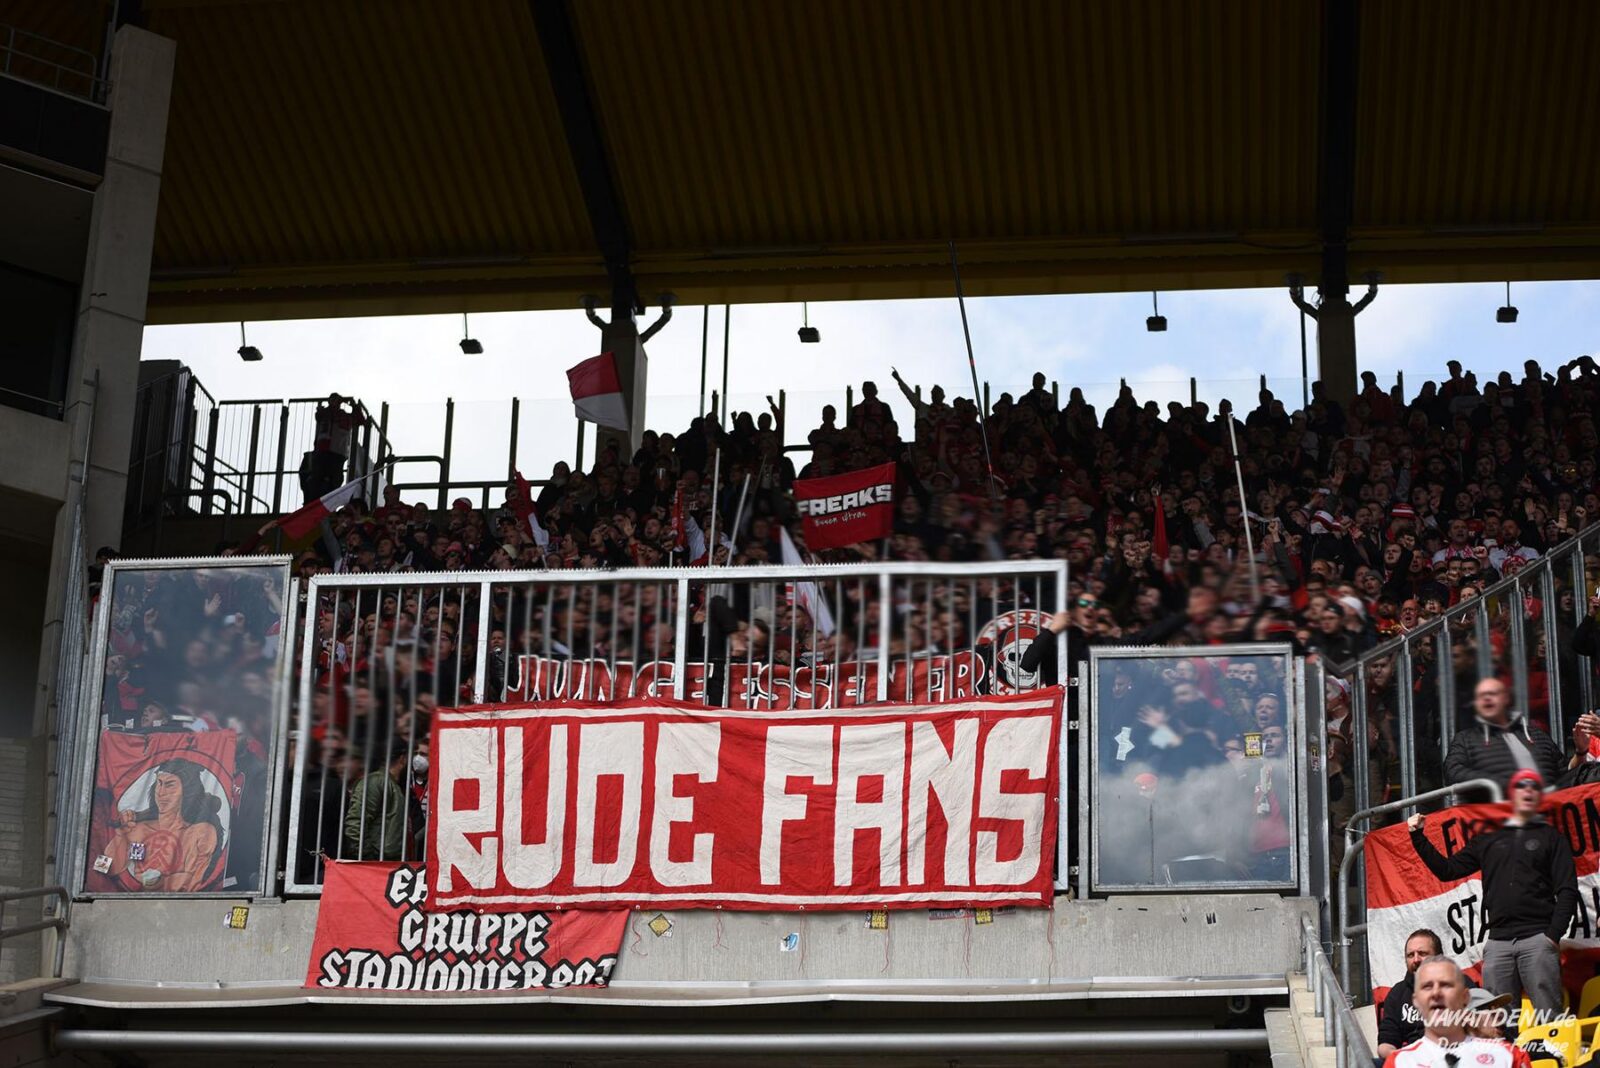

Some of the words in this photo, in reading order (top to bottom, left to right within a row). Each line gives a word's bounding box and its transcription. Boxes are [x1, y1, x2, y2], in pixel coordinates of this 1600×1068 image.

[797, 484, 892, 516] FREAKS
[436, 720, 721, 893] RUDE
[759, 716, 1053, 887] FANS
[399, 909, 550, 955] GRUPPE
